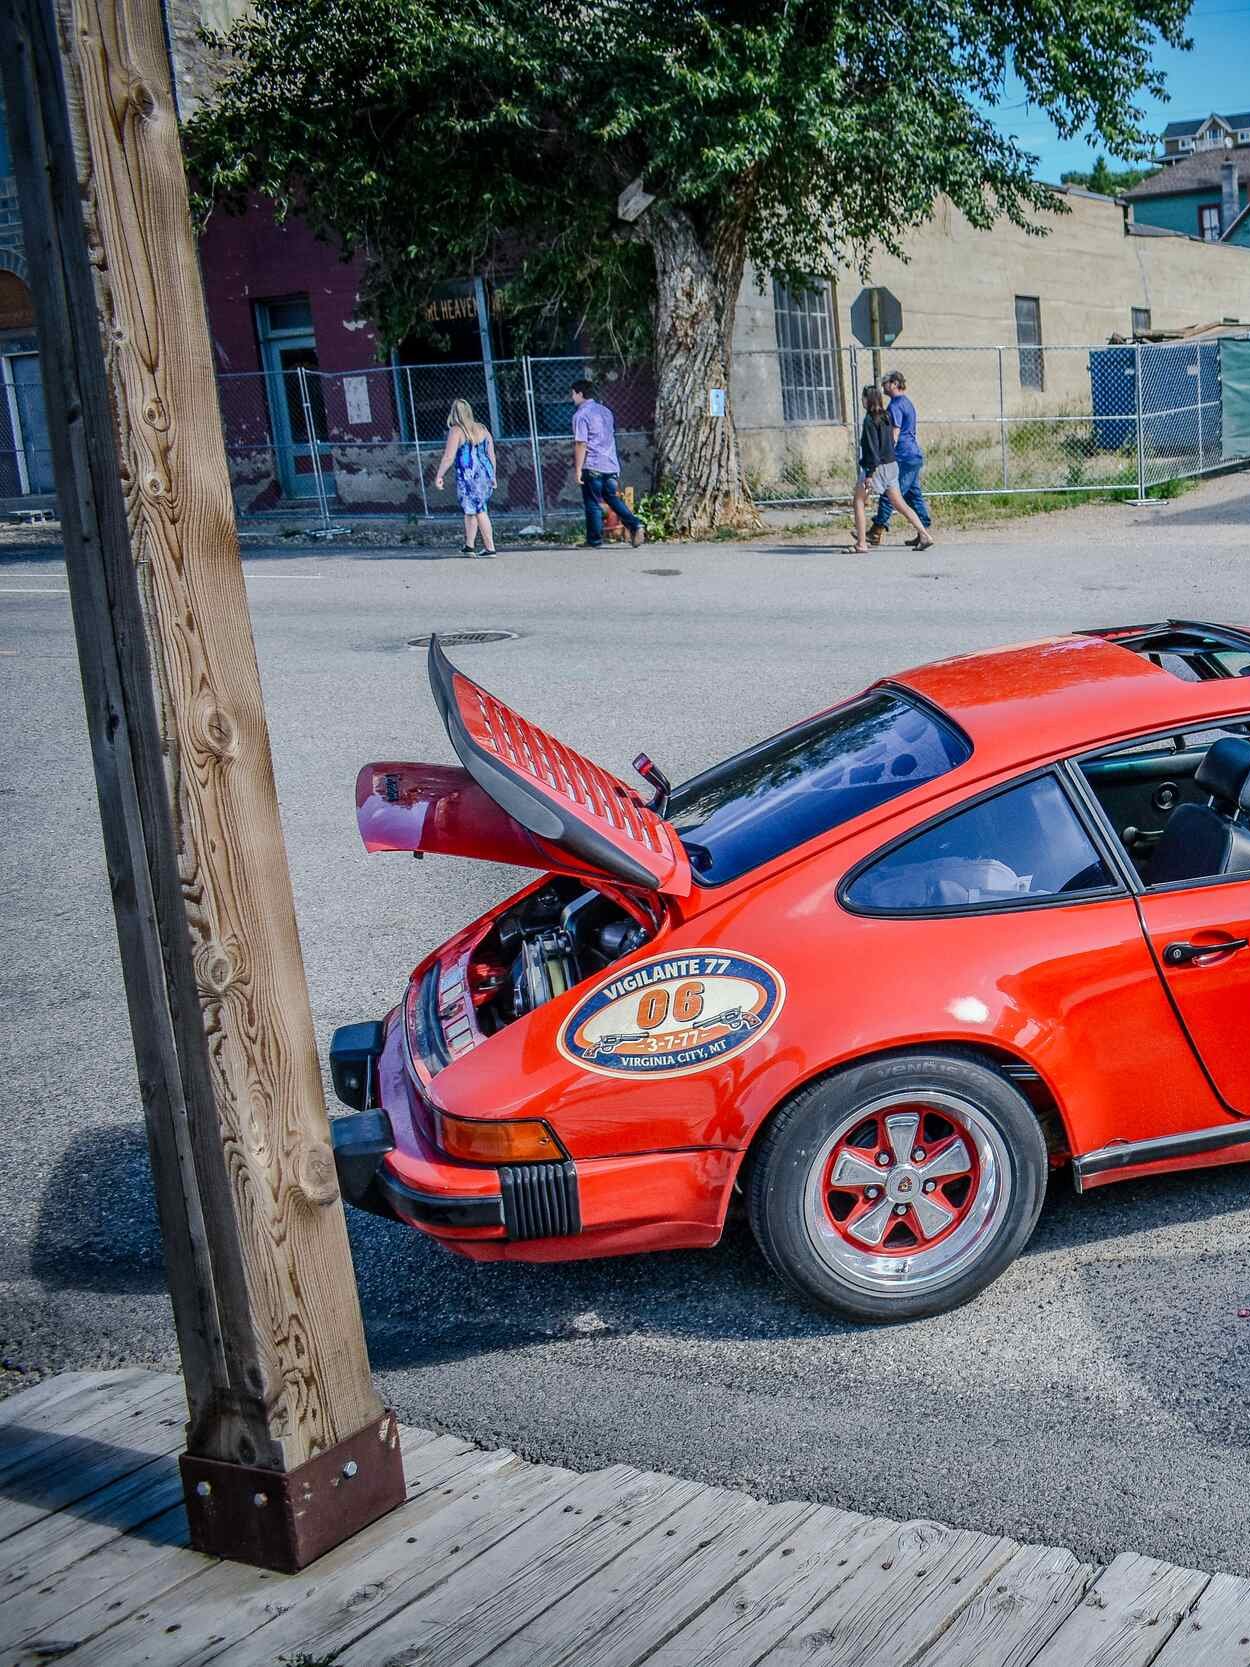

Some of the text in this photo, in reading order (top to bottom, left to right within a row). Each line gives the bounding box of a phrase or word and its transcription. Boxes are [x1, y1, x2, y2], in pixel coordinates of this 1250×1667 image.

[603, 958, 732, 1000] VIGILANTE 77
[636, 981, 705, 1030] 06
[620, 1039, 727, 1067] VIRGINIA CITY, MT
